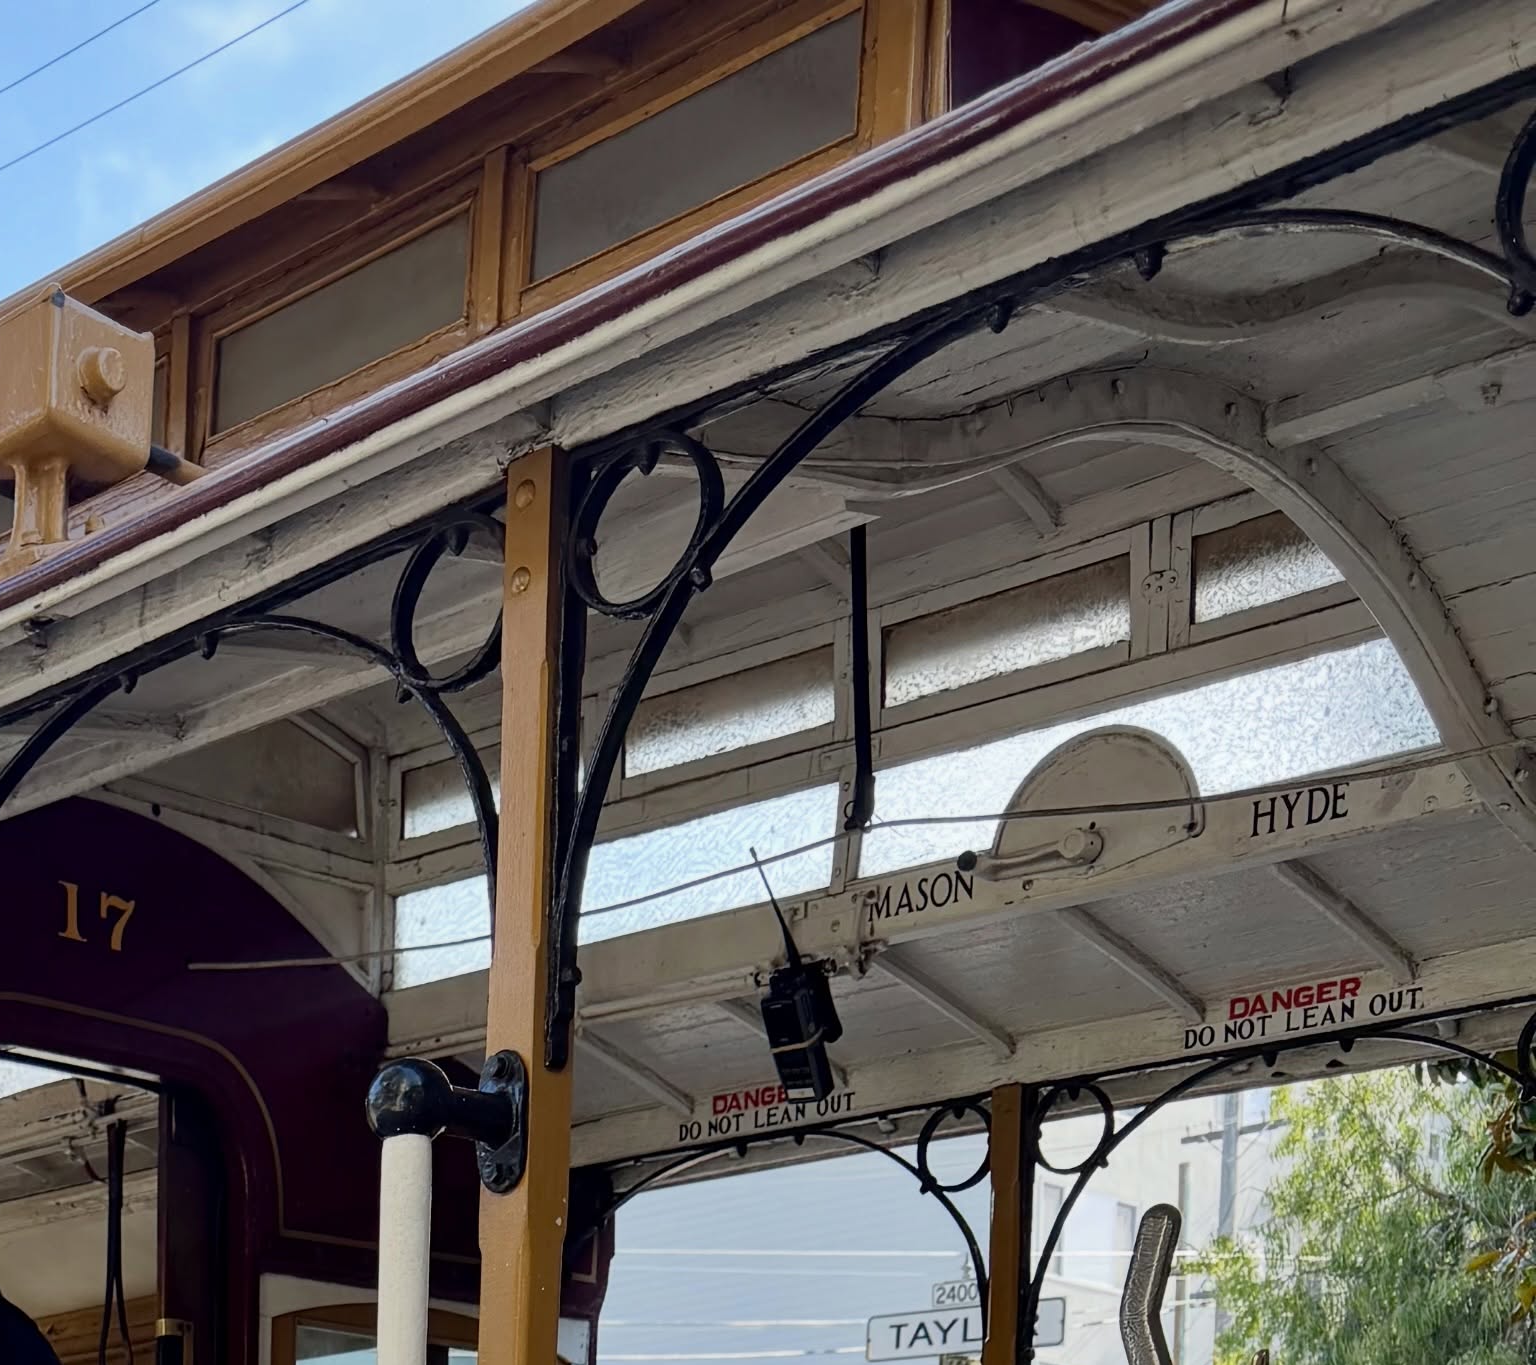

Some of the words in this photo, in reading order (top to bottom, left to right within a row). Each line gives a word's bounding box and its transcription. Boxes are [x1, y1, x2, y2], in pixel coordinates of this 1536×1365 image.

[867, 870, 975, 922] MASON
[1250, 781, 1351, 838] HYDE
[58, 880, 136, 952] 17
[1184, 1026, 1214, 1049] DO
[1223, 1014, 1273, 1043] NOT
[1285, 998, 1356, 1033] LEAN
[1229, 977, 1362, 1021] DANGER
[679, 1121, 702, 1142] DO
[707, 1113, 745, 1137] NOT
[754, 1102, 806, 1129] LEAN
[816, 1092, 856, 1117] OUT
[935, 1282, 978, 1305] 2400
